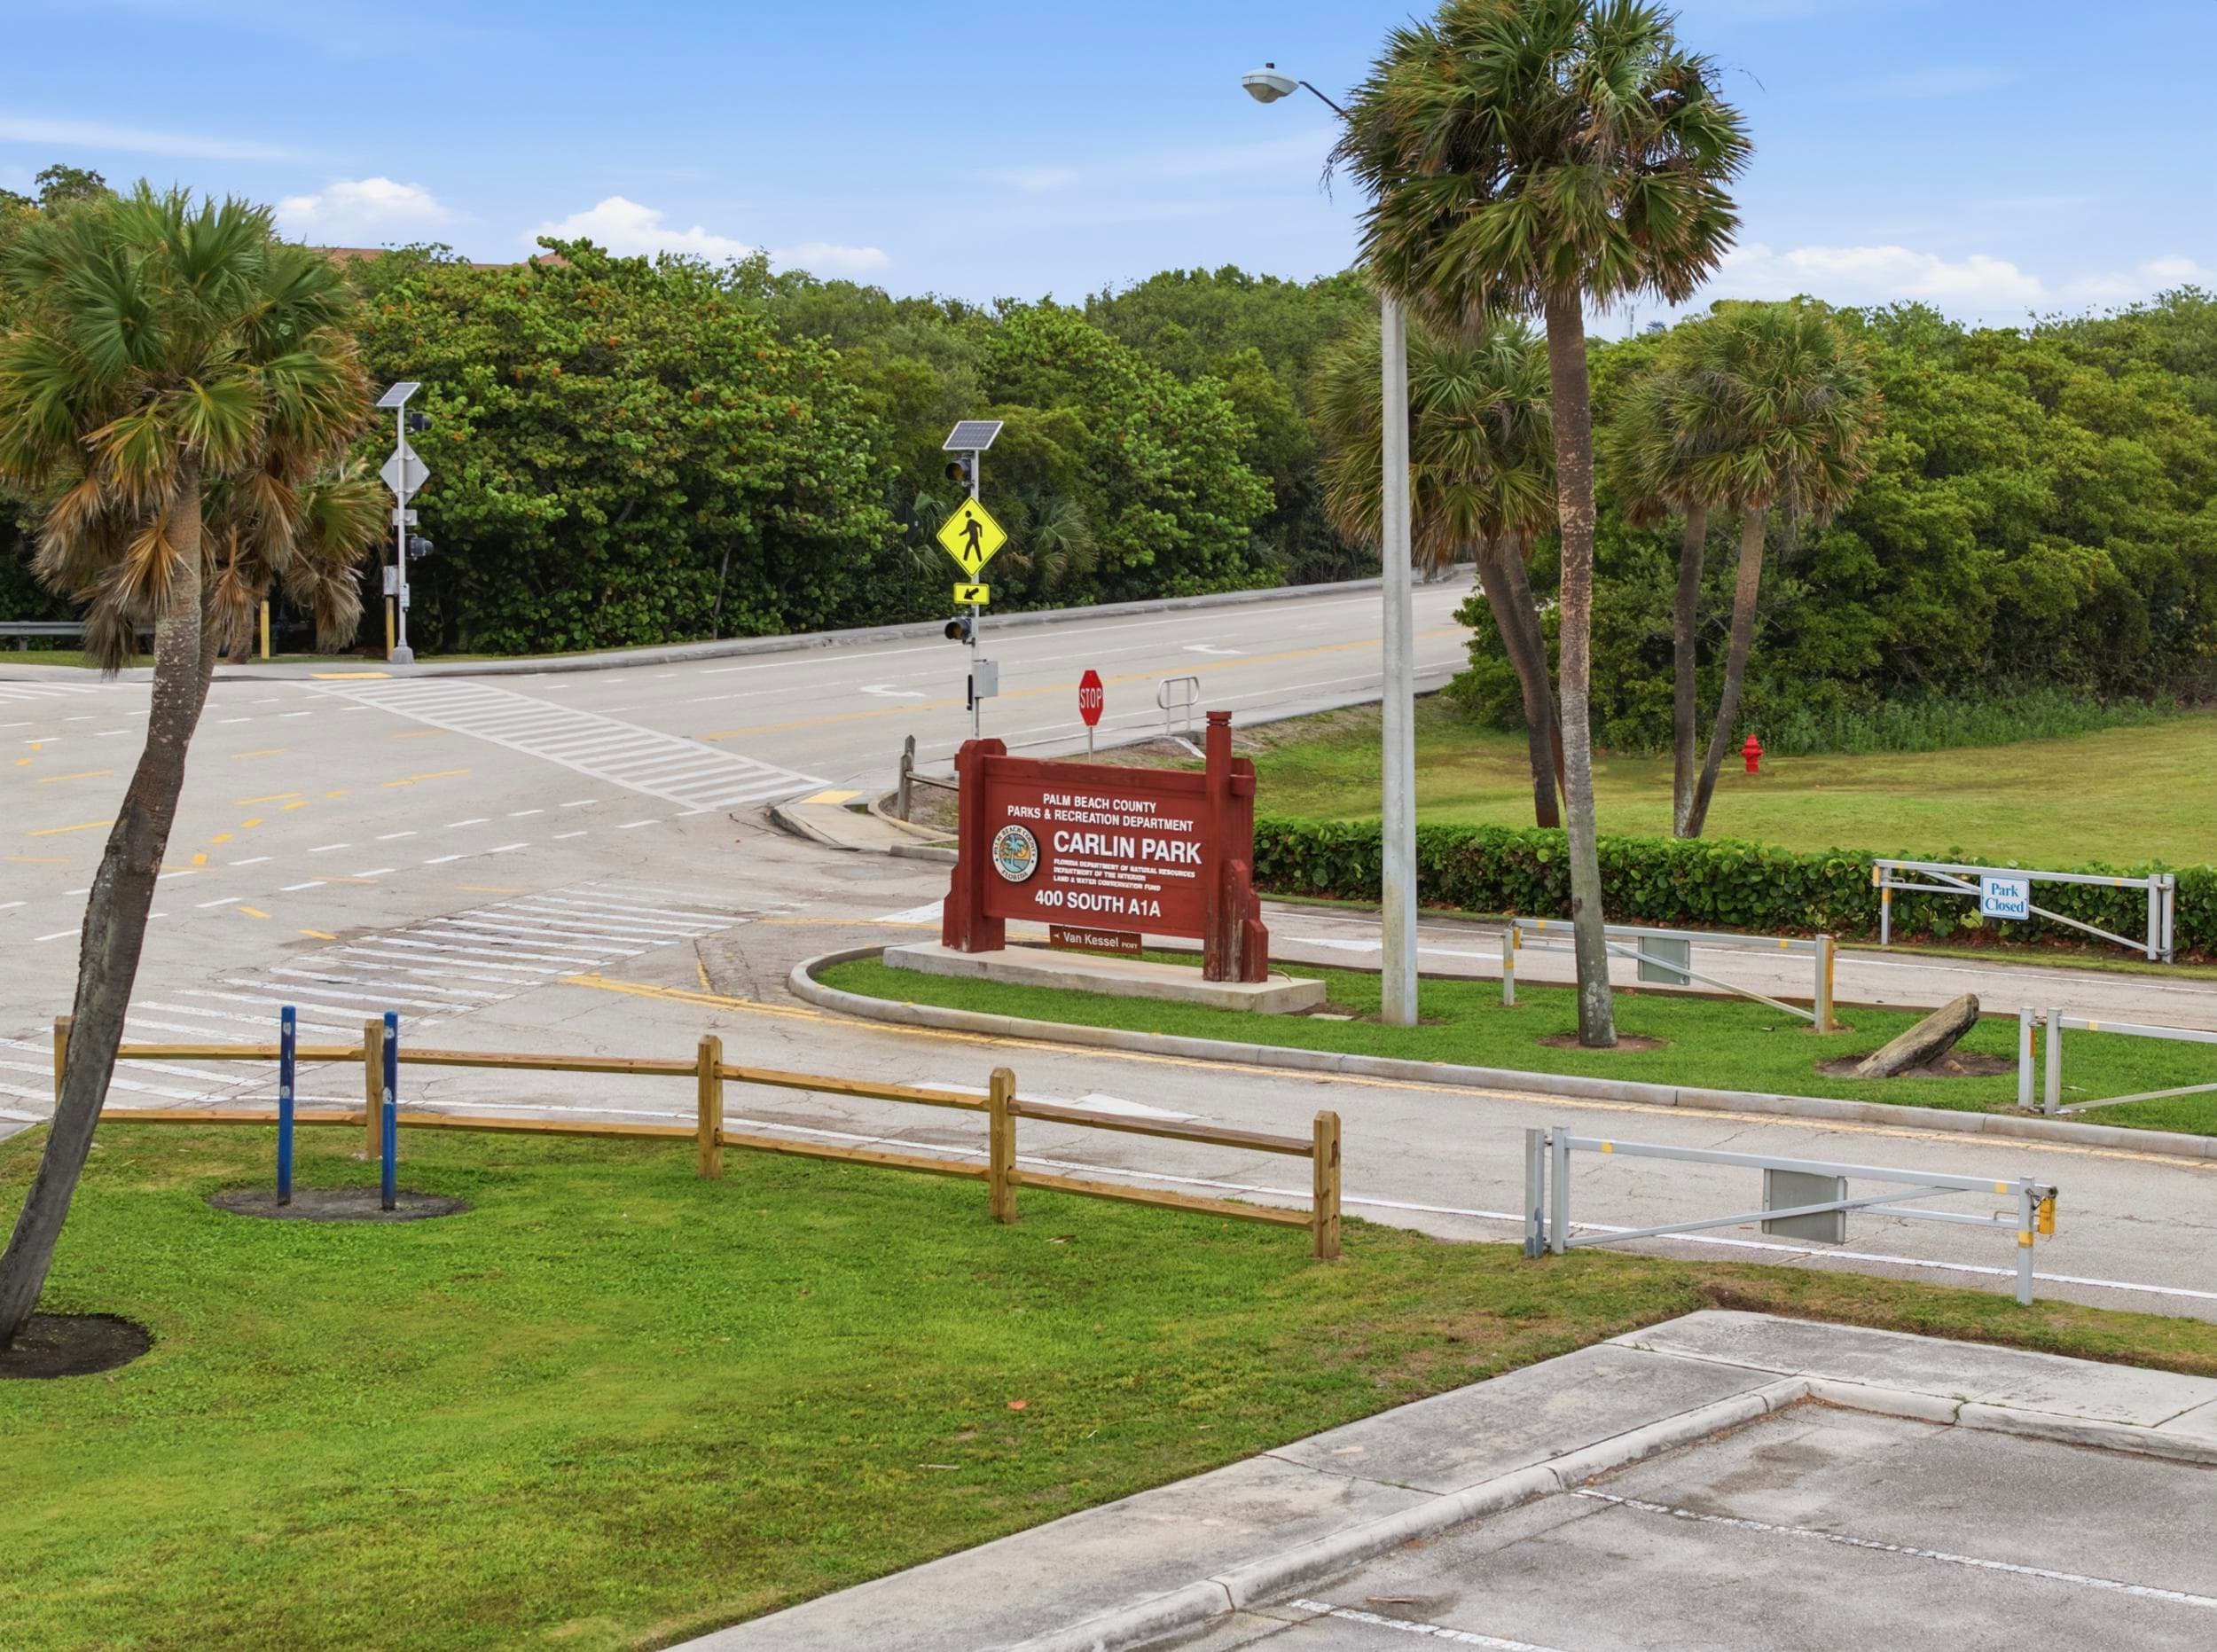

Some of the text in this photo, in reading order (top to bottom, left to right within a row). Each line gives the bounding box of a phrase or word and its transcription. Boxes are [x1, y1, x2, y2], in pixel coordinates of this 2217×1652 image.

[1080, 687, 1102, 709] STOP
[1043, 793, 1156, 813] PALM BEACH COUNTY
[1007, 805, 1194, 832] PARKS & RECREATION DEPARTMENT
[1053, 830, 1202, 865] CARLIN PARK
[1002, 870, 1028, 880] FLORIDA
[1079, 861, 1119, 871] DEPARTMENT
[1158, 868, 1195, 878] RESOURCES
[1991, 882, 2019, 897] Park
[1035, 889, 1162, 917] 400 SOUTH A1A
[1985, 897, 2024, 913] Closed
[1063, 931, 1082, 943] Van
[1085, 934, 1119, 948] Kessel
